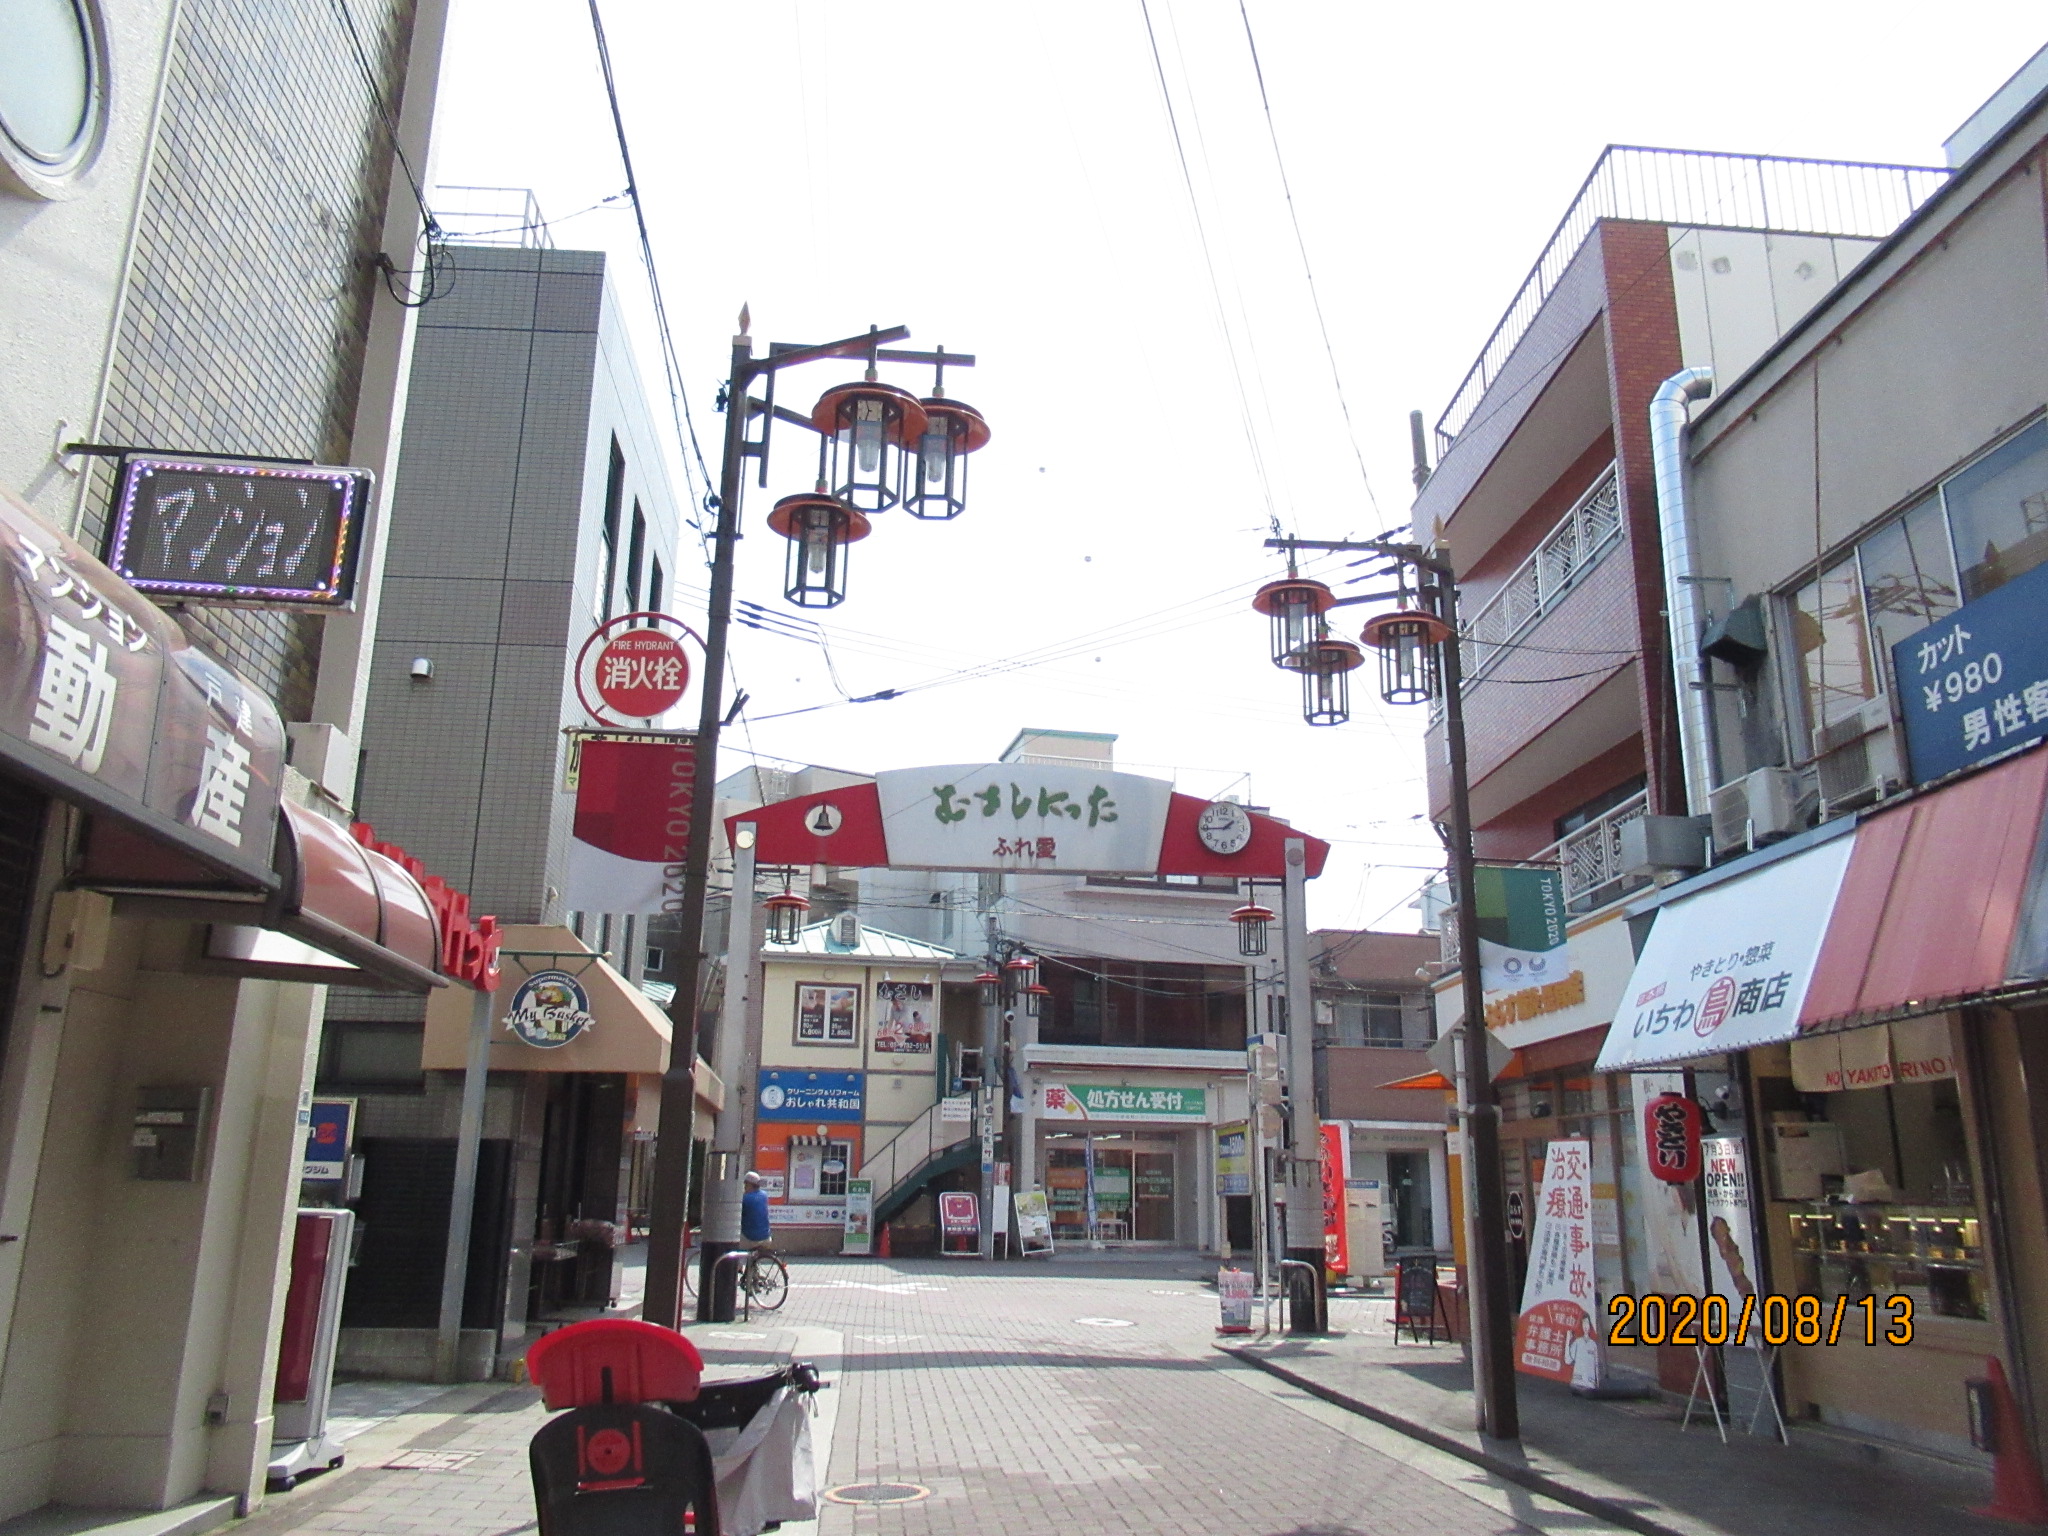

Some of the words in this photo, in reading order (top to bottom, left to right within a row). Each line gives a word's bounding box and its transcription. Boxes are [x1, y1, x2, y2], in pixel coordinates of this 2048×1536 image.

[612, 641, 632, 650] FIRE
[634, 641, 675, 650] HYDRANT
[1917, 624, 1972, 674] カット
[603, 656, 683, 691] 消火栓
[993, 837, 1056, 859] ふれ愛
[1540, 877, 1557, 916] TOKYO
[1545, 916, 1560, 946] 2020
[527, 975, 577, 989] Supermarket
[878, 983, 923, 1001] むさし
[507, 1008, 537, 1025] My
[543, 1006, 590, 1026] Basket
[785, 1098, 860, 1110] おしゃれ共和国
[1046, 1088, 1066, 1110] 薬
[1087, 1089, 1184, 1111] 処方せん受付
[1711, 1158, 1736, 1173] NEW
[1546, 1147, 1567, 1218] 治療
[1706, 1172, 1745, 1187] OPEN!!
[1566, 1146, 1588, 1299] 交通事故
